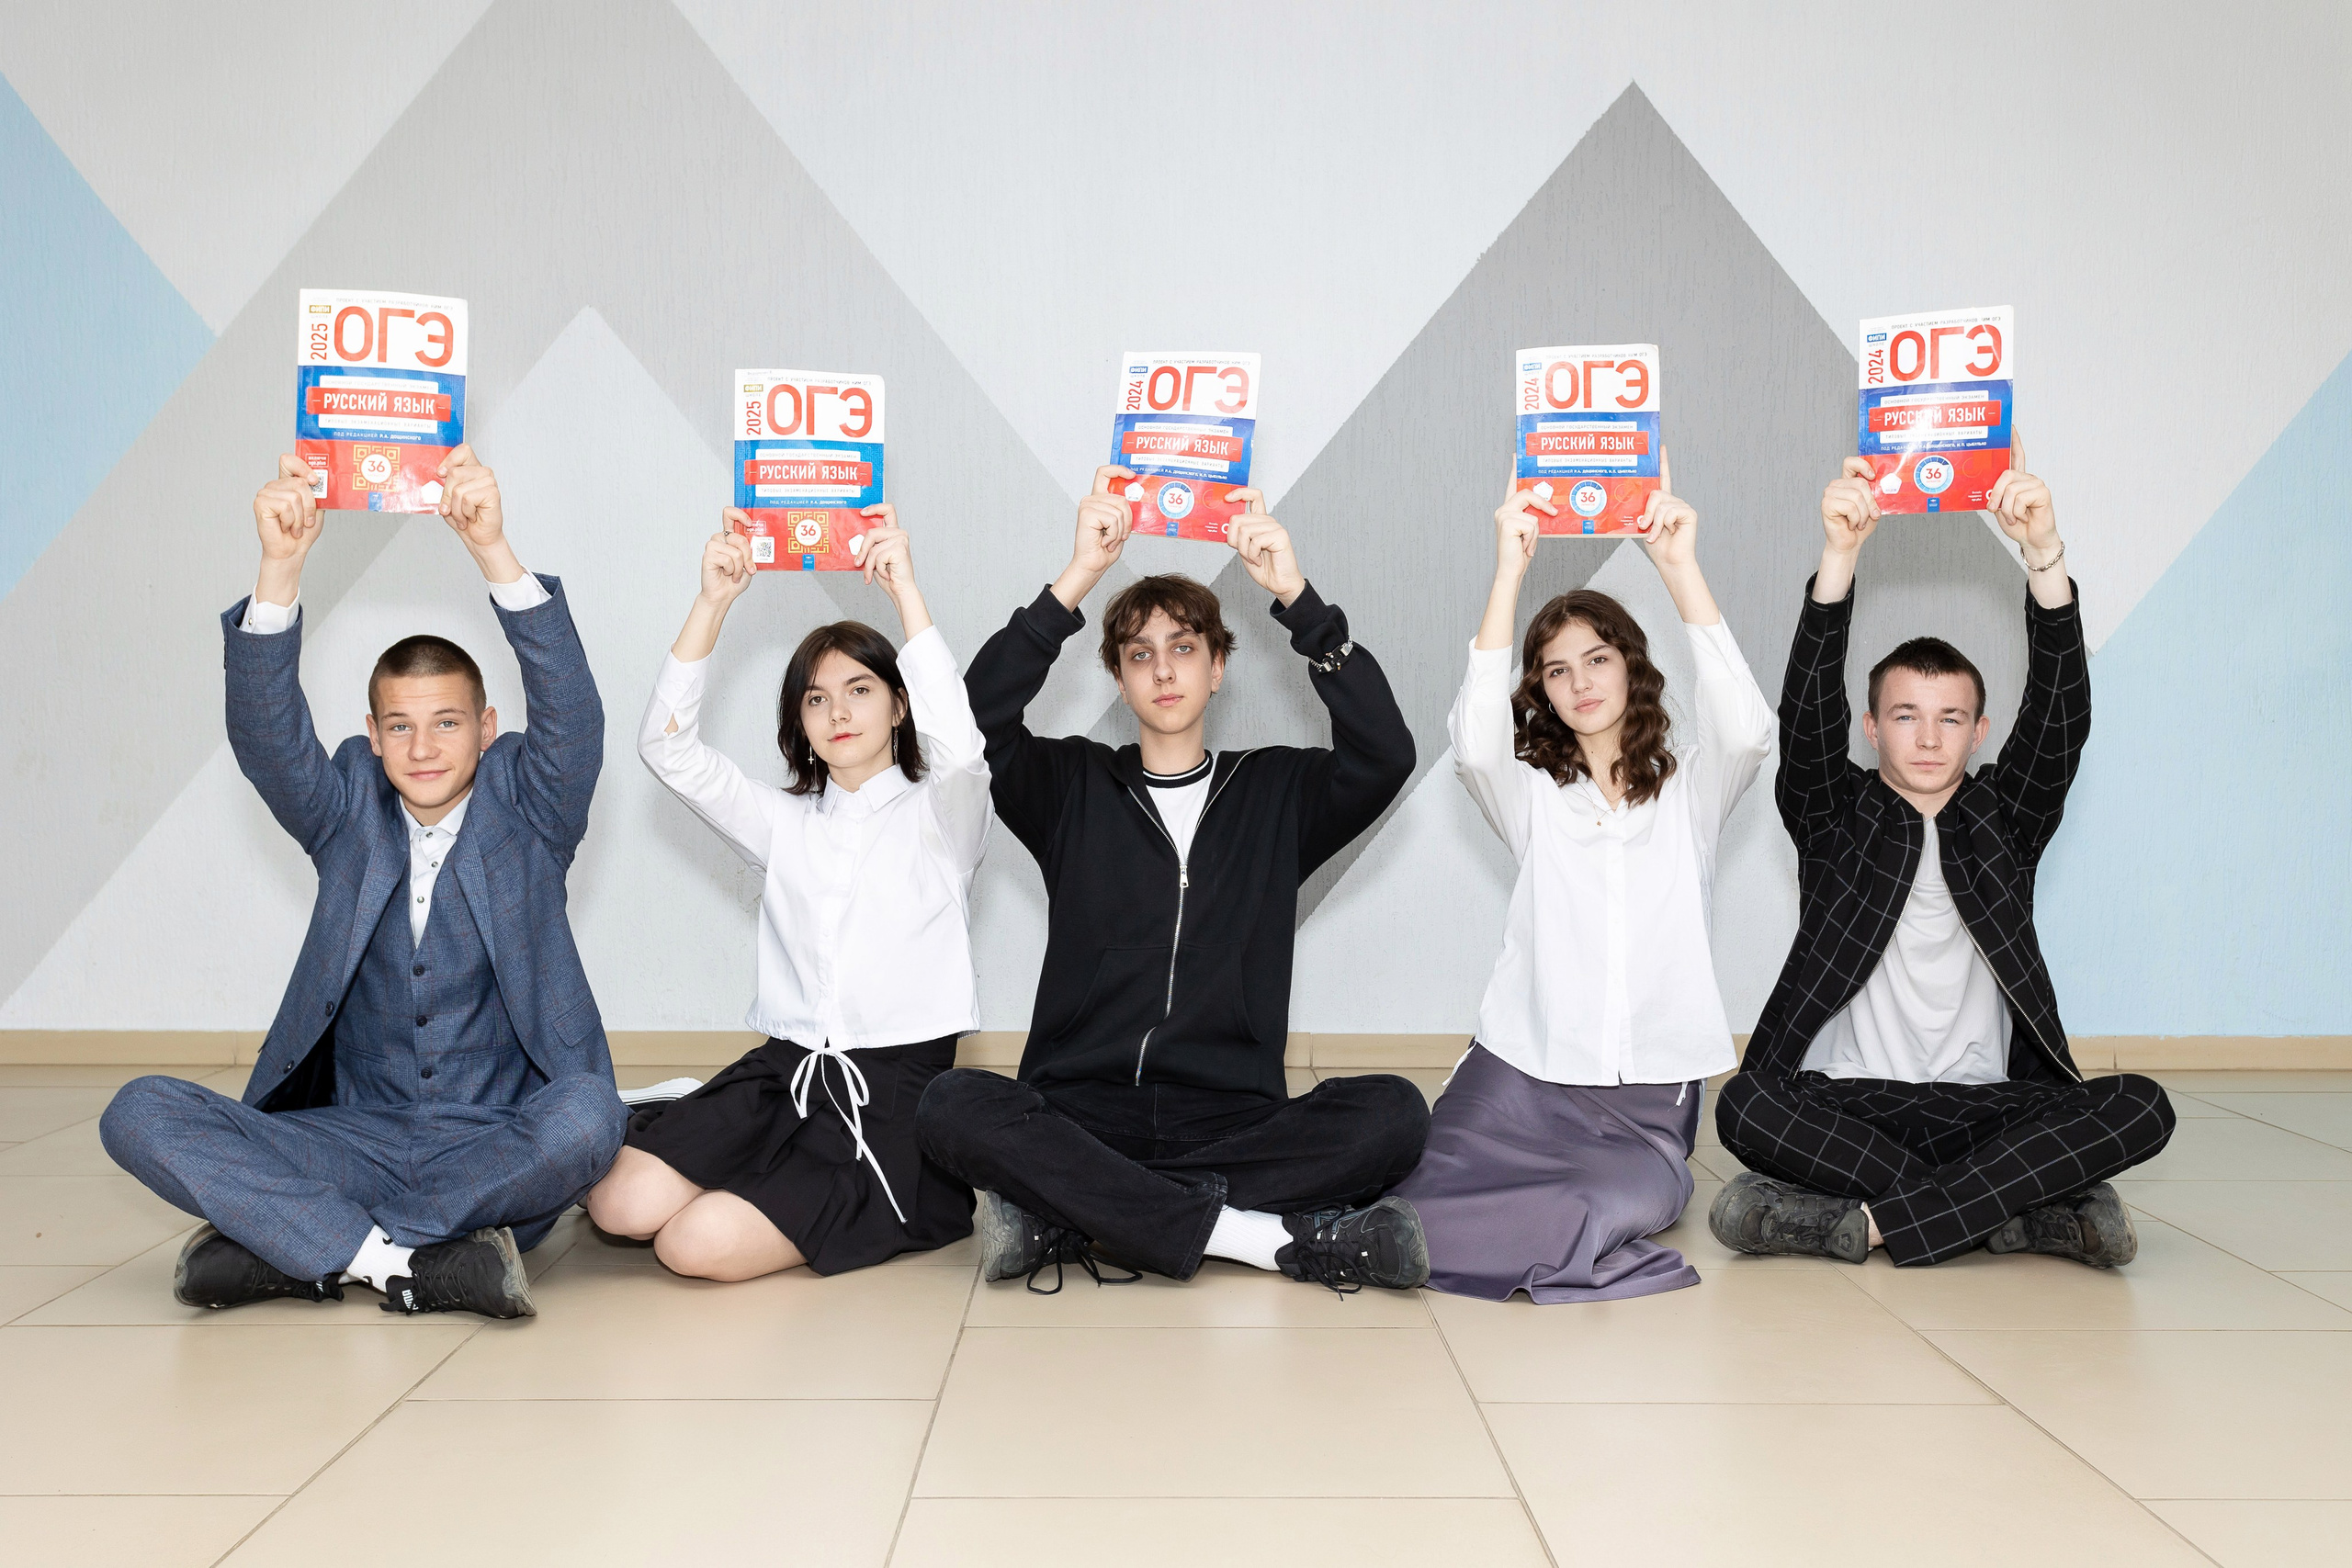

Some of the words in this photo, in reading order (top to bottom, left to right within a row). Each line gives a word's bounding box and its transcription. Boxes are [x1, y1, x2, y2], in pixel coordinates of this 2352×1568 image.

[311, 305, 330, 313] ФИПИ
[311, 323, 328, 360] 2025
[334, 306, 454, 367] ОГЭ
[1869, 333, 1885, 342] ФИПИ
[1889, 324, 2002, 382] ОГЭ
[1868, 349, 1883, 385] 2024
[1147, 366, 1250, 413] ОГЭ
[1524, 378, 1540, 411] 2024
[1544, 359, 1649, 409] ОГЭ
[323, 392, 387, 412] РУССКИЙ
[393, 396, 435, 414] ЯЗЫК
[1126, 380, 1144, 411] 2024
[746, 400, 761, 435] 2025
[766, 384, 873, 438] ОГЭ
[1884, 405, 1942, 426] РУССКИЙ
[1948, 407, 1986, 423] ЯЗЫК
[1136, 434, 1190, 451] РУССКИЙ
[1193, 439, 1229, 456] ЯЗЫК
[1541, 434, 1595, 450] РУССКИЙ
[1600, 436, 1634, 450] ЯЗЫК
[368, 460, 385, 473] 36
[759, 462, 816, 479] РУССКИЙ
[821, 466, 858, 480] ЯЗЫК
[1926, 468, 1942, 479] 36
[1168, 493, 1183, 505] 36
[1580, 492, 1596, 502] 36
[800, 525, 817, 536] 36
